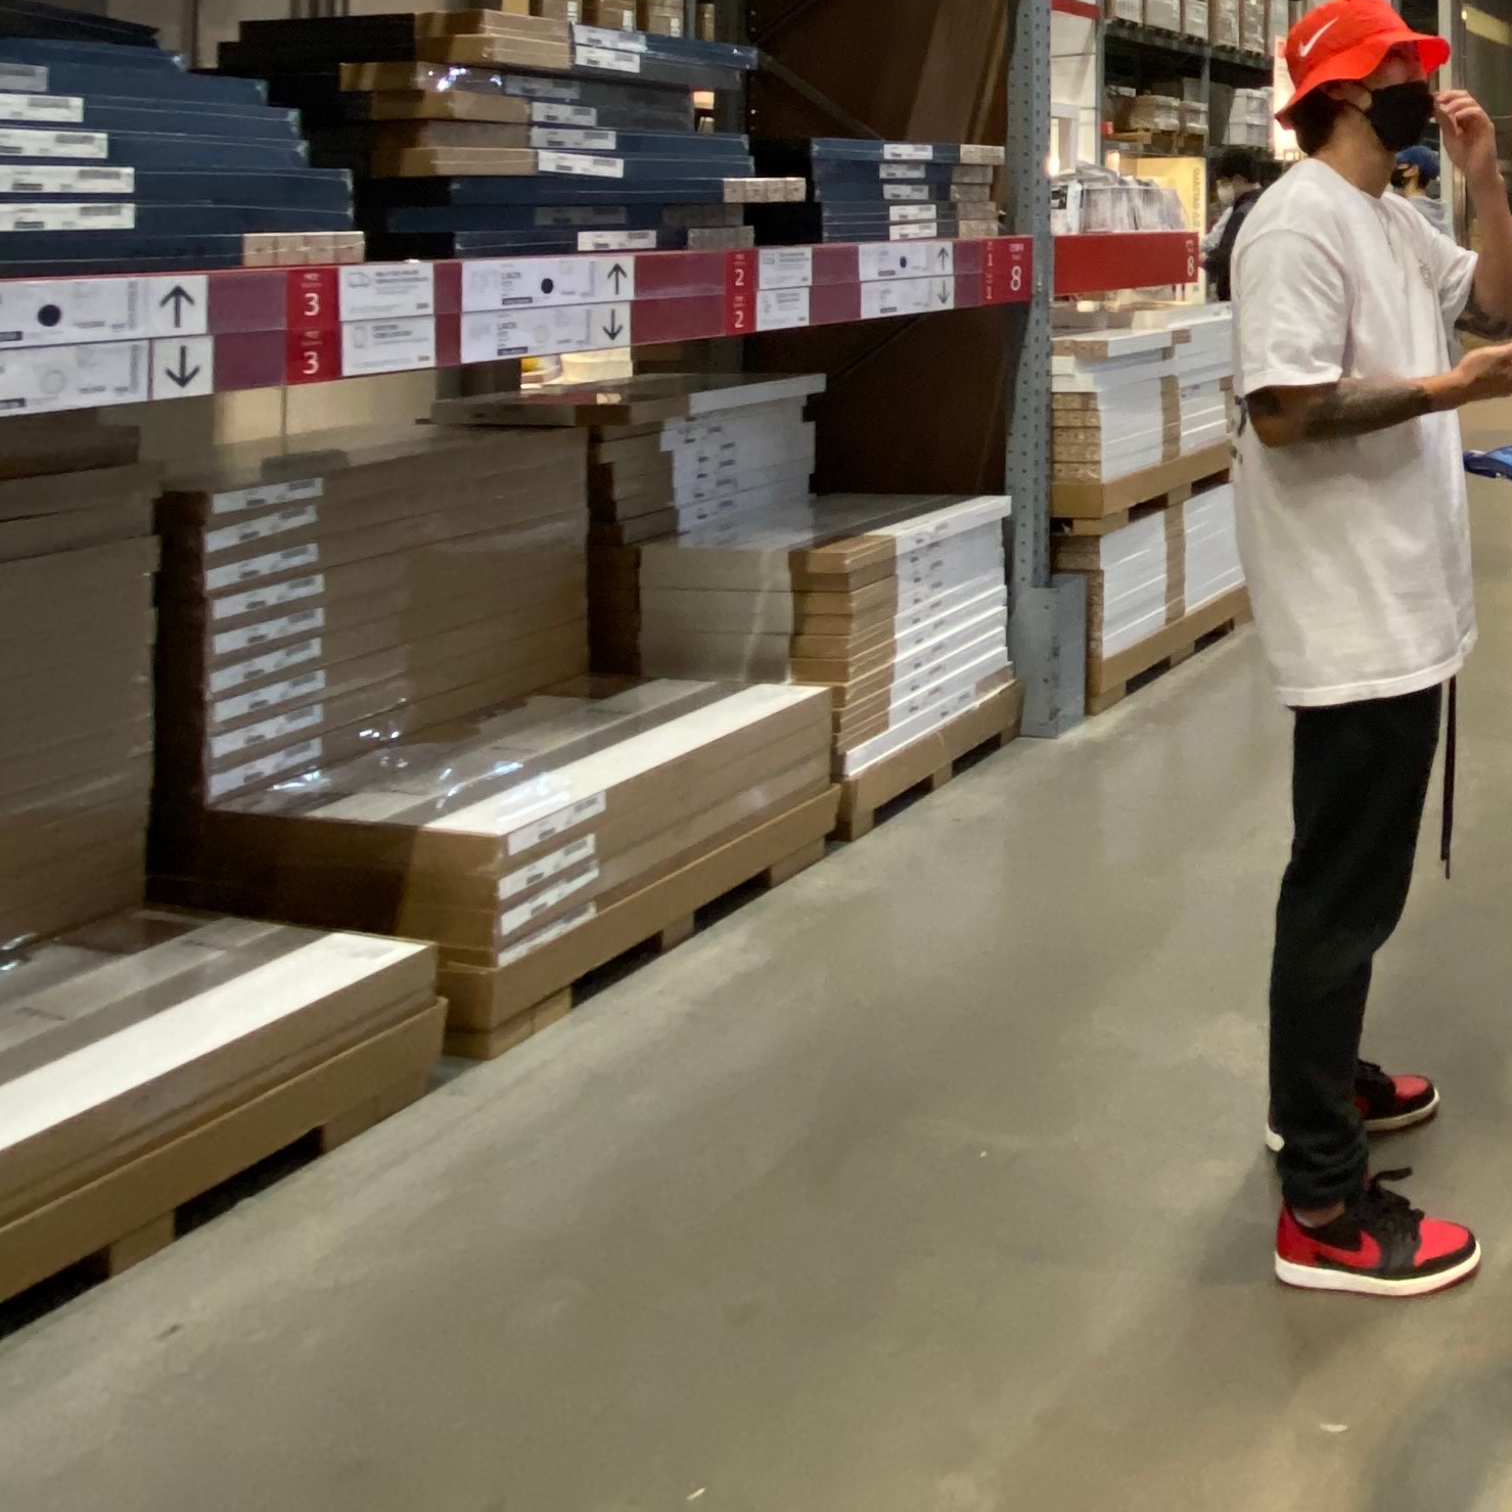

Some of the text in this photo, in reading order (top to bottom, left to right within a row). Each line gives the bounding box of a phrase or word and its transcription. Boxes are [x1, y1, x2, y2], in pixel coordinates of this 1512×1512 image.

[734, 269, 745, 286] 2
[1010, 266, 1022, 291] 8
[303, 293, 320, 316] 3
[734, 311, 745, 328] 2
[302, 351, 320, 374] 3
